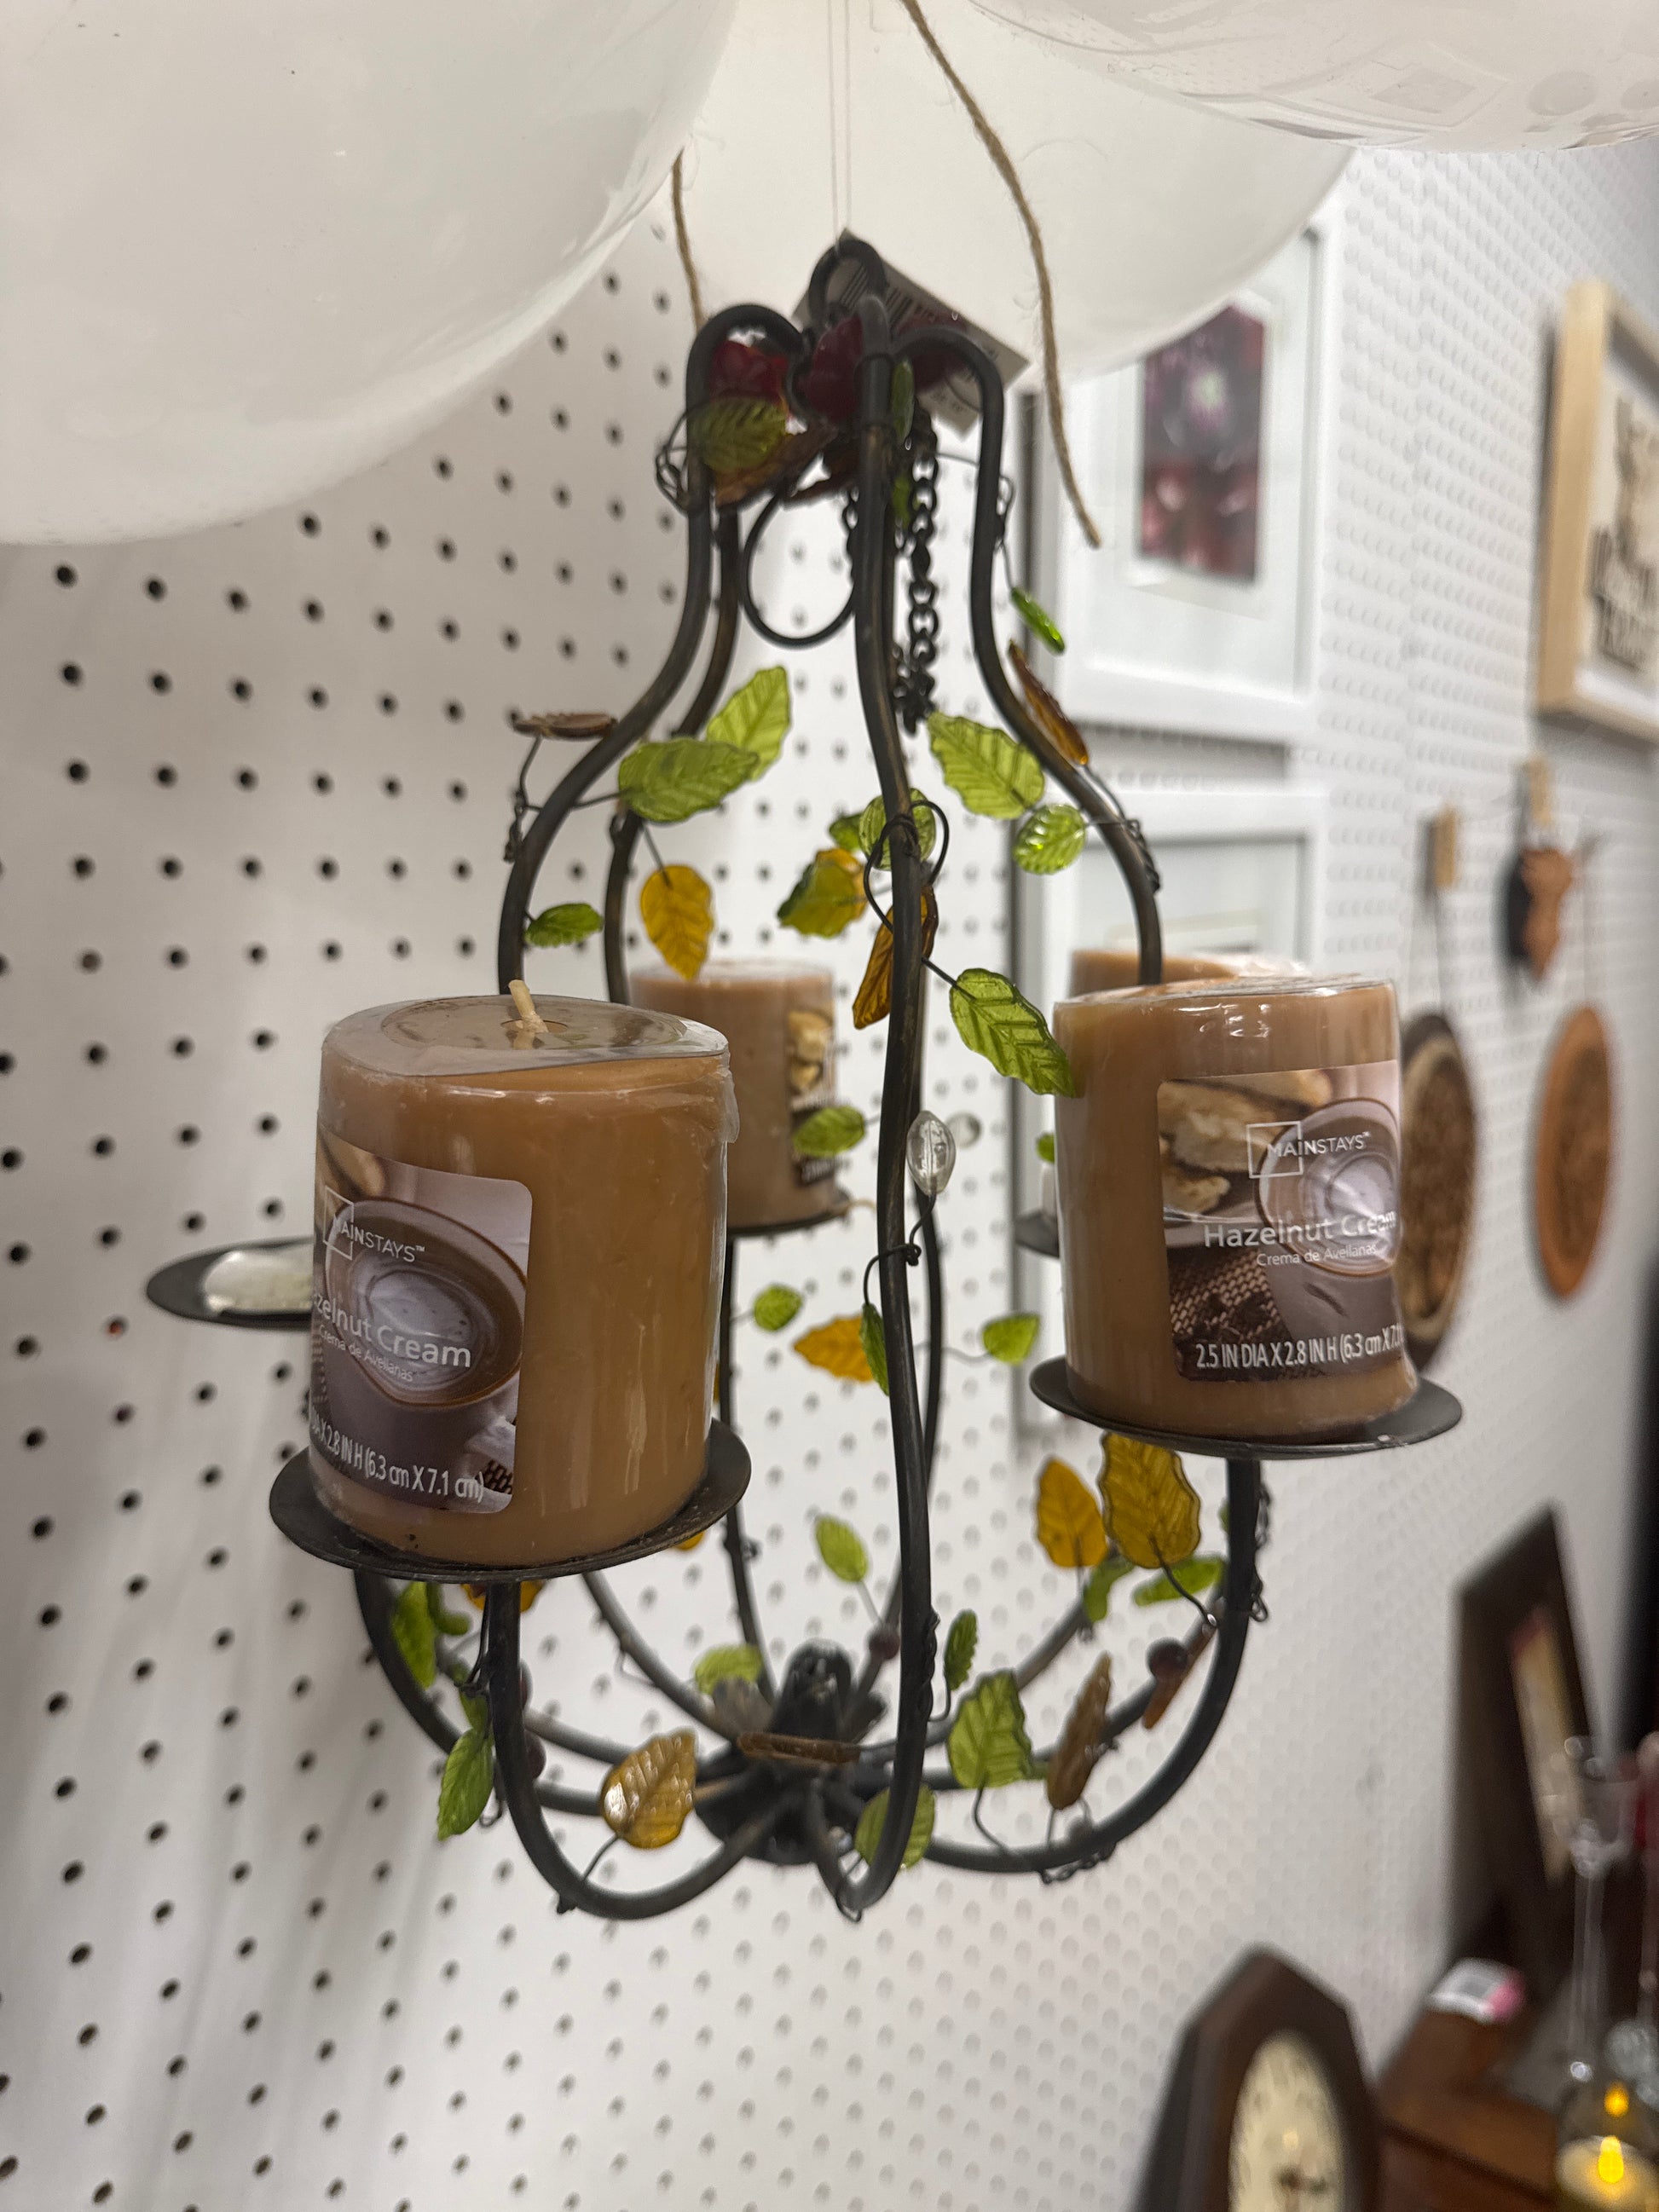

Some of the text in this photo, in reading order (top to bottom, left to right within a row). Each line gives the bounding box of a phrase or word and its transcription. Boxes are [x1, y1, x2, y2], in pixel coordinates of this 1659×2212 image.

[1204, 1219, 1334, 1247] Hazelnut
[1257, 1244, 1378, 1267] Crema de Avellanas
[349, 1341, 361, 1358] de
[364, 1349, 413, 1382] Avellanas
[377, 1325, 471, 1368] Cream
[1195, 1343, 1219, 1368] 2.5
[1222, 1343, 1238, 1368] IN
[1240, 1343, 1269, 1367] DIA
[1270, 1342, 1283, 1366] X
[1284, 1340, 1306, 1365] 2.8
[1309, 1338, 1325, 1363] IN
[1327, 1337, 1337, 1361] H
[1340, 1332, 1363, 1364] (6.3
[1365, 1335, 1382, 1355] cm
[1382, 1327, 1390, 1351] X
[327, 1424, 340, 1456] 2.8
[341, 1434, 354, 1461] IN
[354, 1441, 363, 1470] H
[365, 1447, 386, 1480] (6.3
[389, 1465, 409, 1489] cm
[412, 1464, 425, 1492] X
[427, 1467, 448, 1496] 7.1
[454, 1470, 484, 1504] cm)
